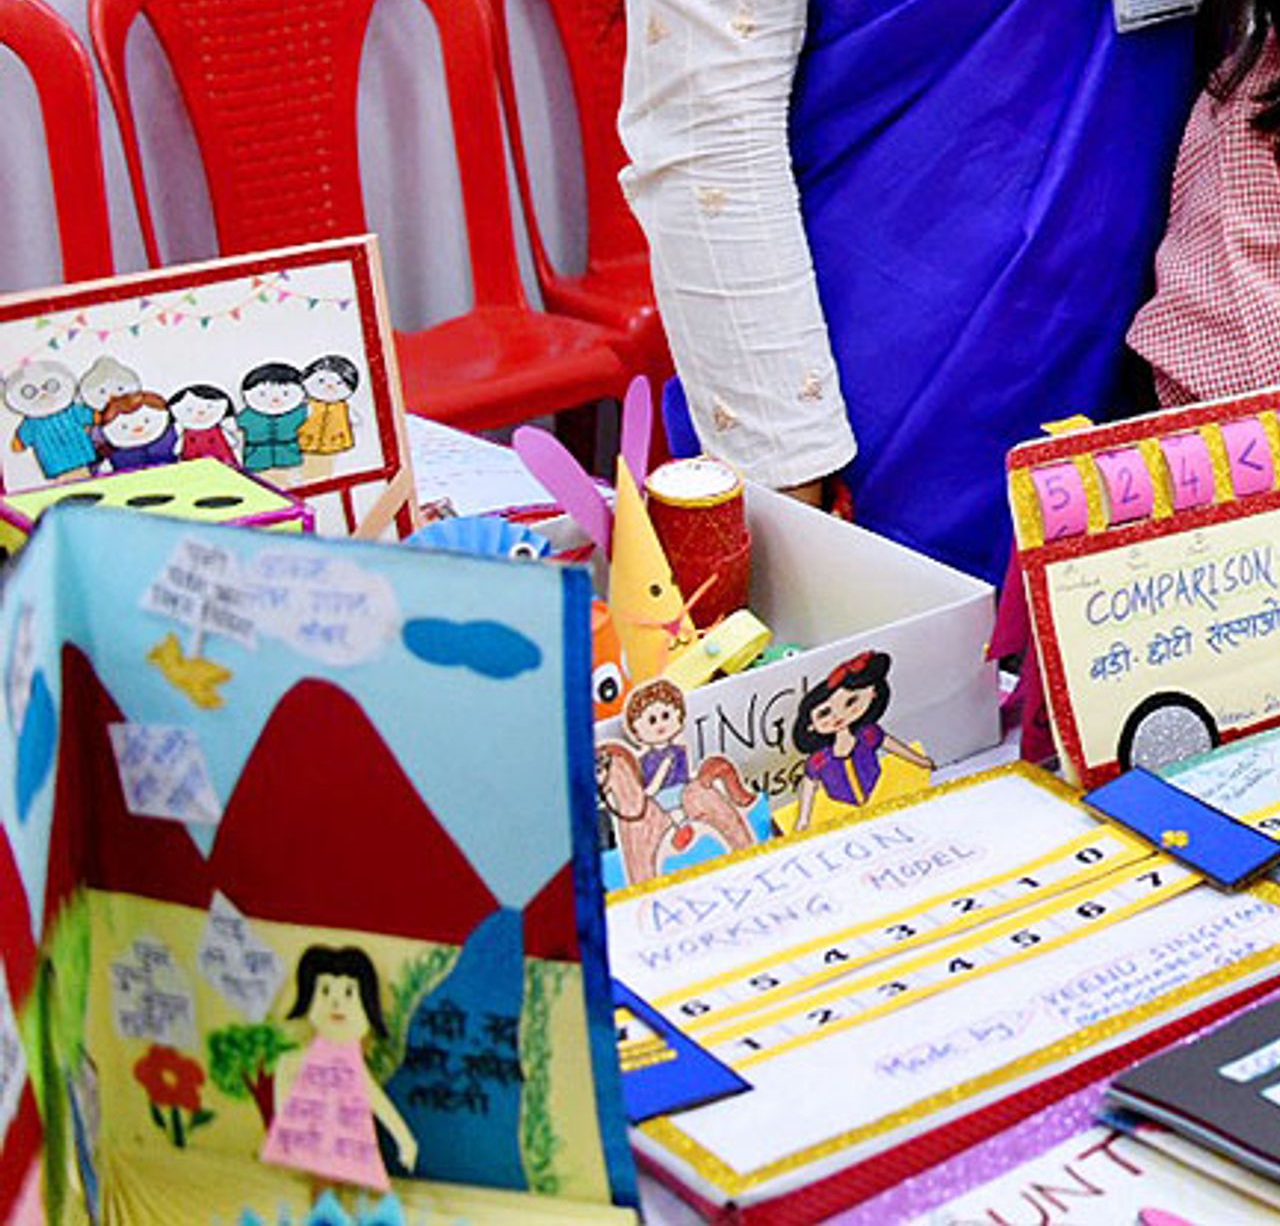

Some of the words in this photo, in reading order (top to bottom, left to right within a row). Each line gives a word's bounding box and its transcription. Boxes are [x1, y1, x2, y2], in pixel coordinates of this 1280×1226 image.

[1046, 476, 1071, 511] 5
[1119, 466, 1141, 505] 2
[1180, 456, 1199, 499] 4
[1086, 546, 1278, 625] COMPARISON
[638, 892, 831, 969] WORKING
[868, 840, 975, 891] MODEL
[650, 825, 915, 932] ADDITION
[680, 999, 711, 1017] 6
[749, 973, 780, 991] 5
[824, 948, 850, 965] 4
[885, 923, 917, 941] 3
[951, 897, 984, 914] 2
[1017, 876, 1041, 888] 1
[1075, 847, 1104, 865] 0
[738, 1036, 762, 1050] 1
[807, 1008, 841, 1026] 2
[878, 980, 908, 998] 3
[949, 956, 975, 974] 4
[1010, 928, 1042, 949] 5
[1075, 900, 1107, 920] 6
[1135, 870, 1163, 888] 7
[952, 1130, 1144, 1226] UNT
